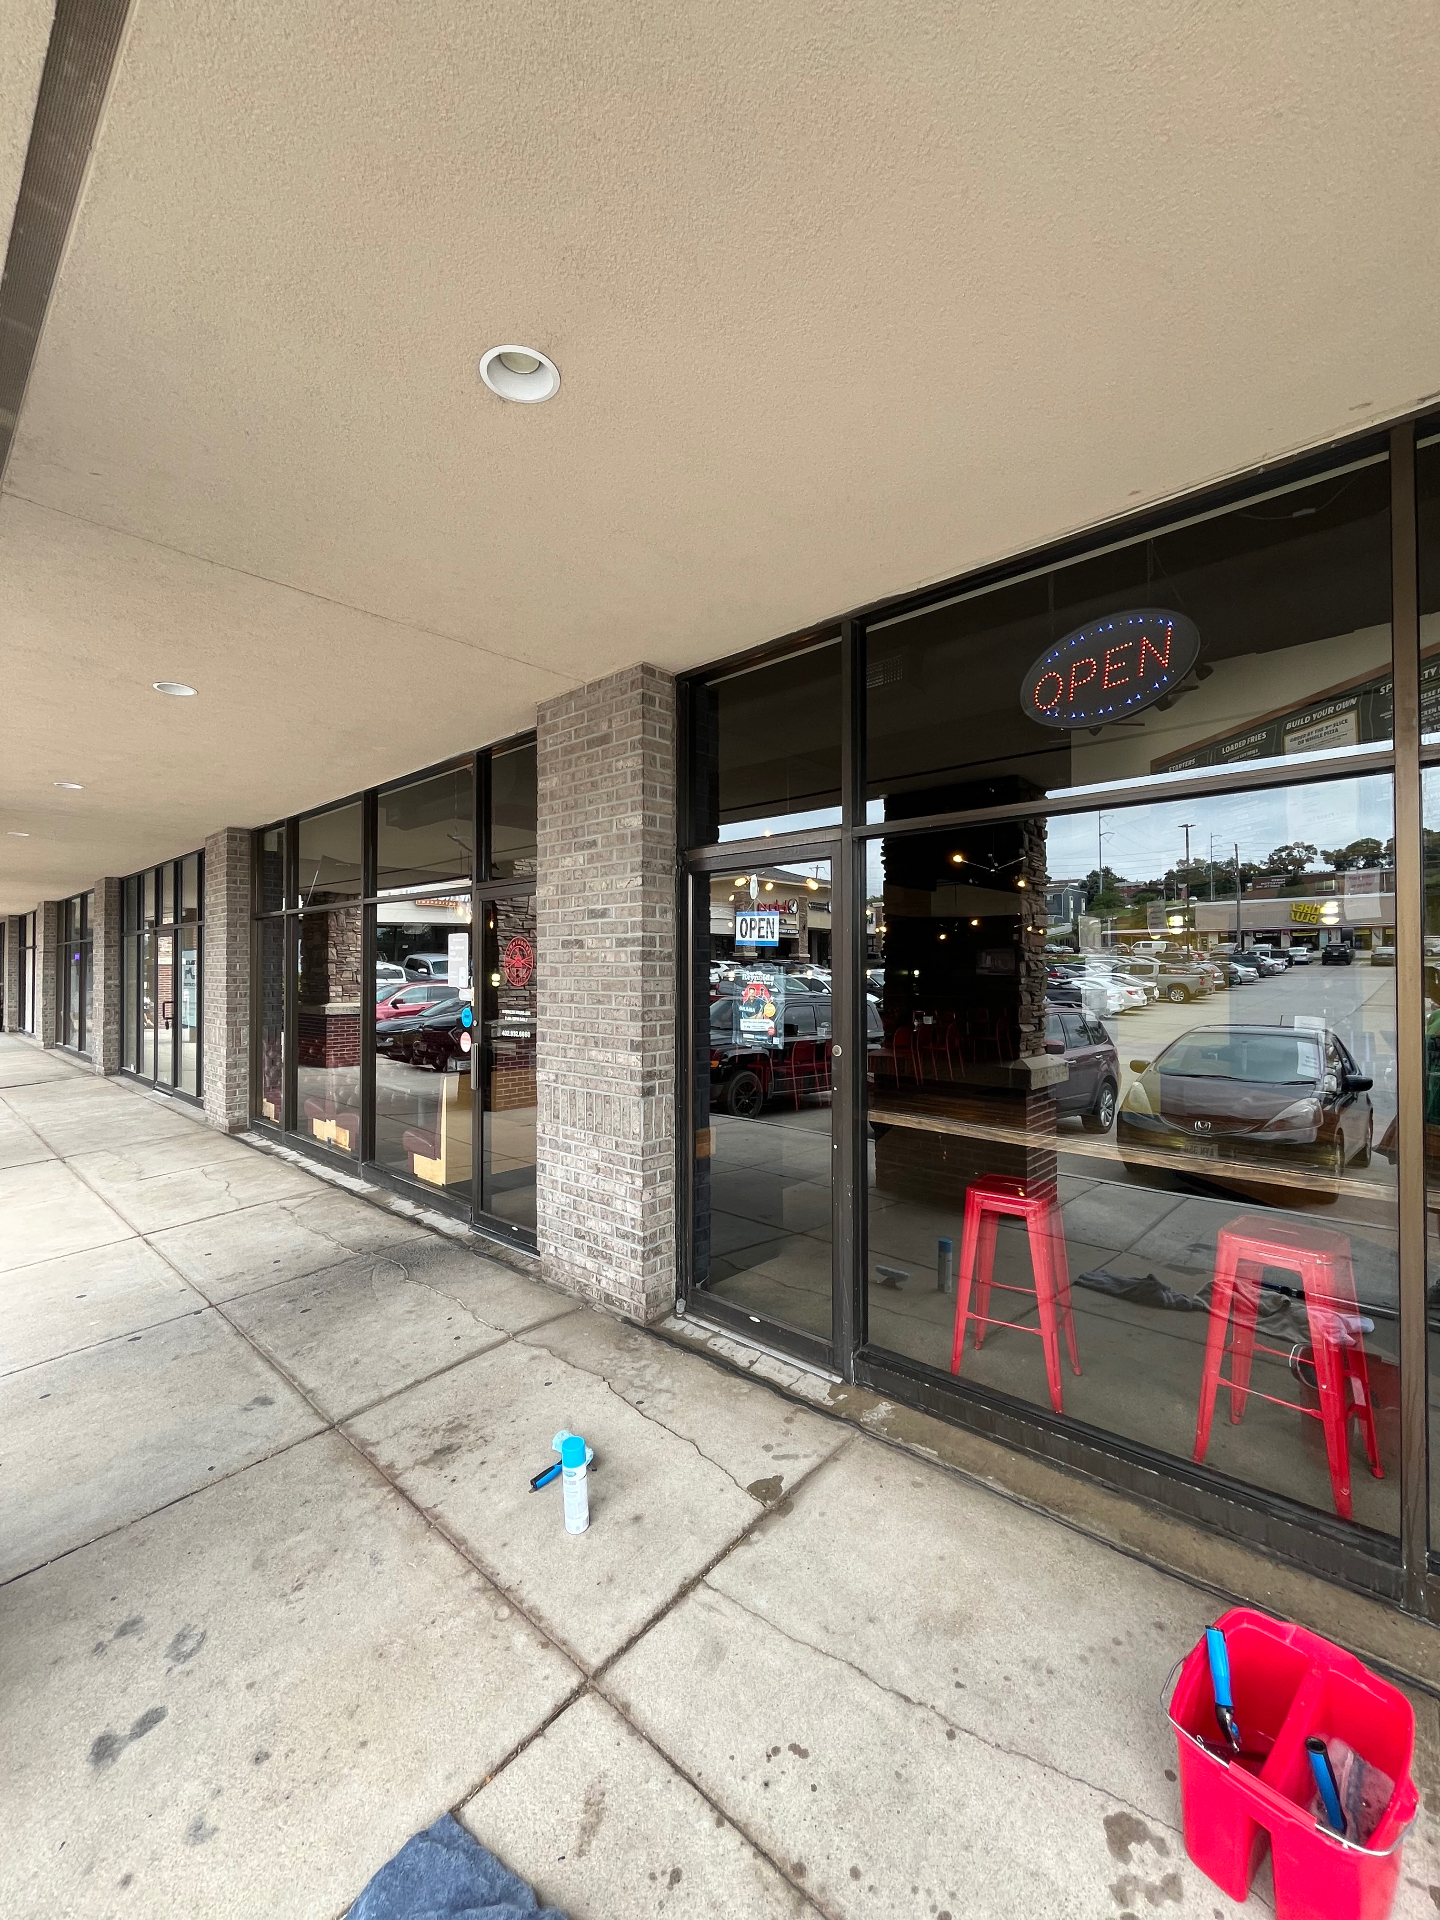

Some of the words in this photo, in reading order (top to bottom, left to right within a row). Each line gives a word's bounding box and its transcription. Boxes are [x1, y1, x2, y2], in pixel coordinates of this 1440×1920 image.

[1034, 625, 1173, 711] OPEN
[1286, 715, 1311, 730] BUILD
[1312, 706, 1334, 720] YOUR
[1335, 697, 1358, 711] OWN
[1222, 740, 1247, 755] LOADED
[1246, 731, 1267, 745] FRIES
[1168, 758, 1196, 772] STARTERS
[740, 917, 775, 939] OPEN
